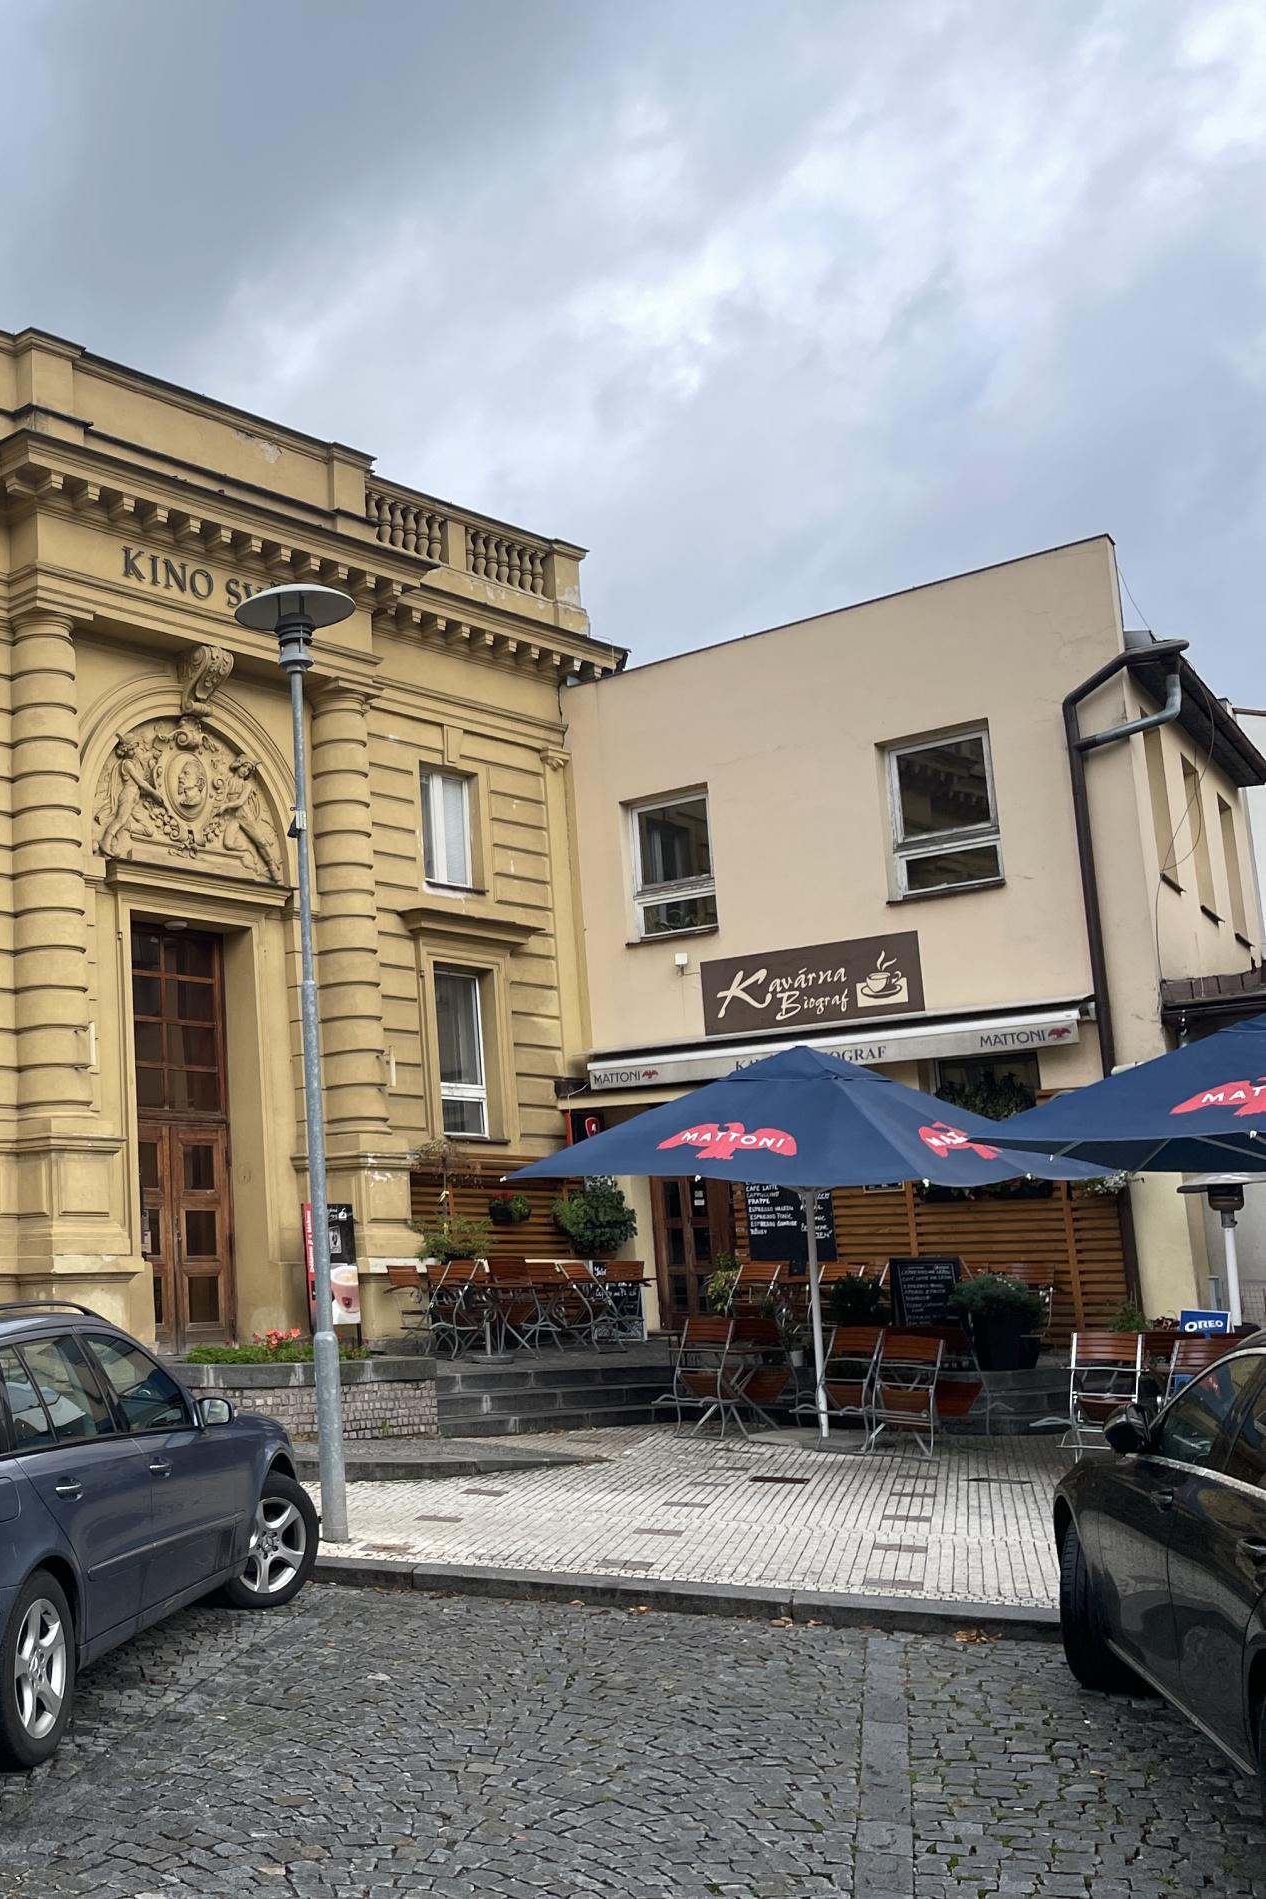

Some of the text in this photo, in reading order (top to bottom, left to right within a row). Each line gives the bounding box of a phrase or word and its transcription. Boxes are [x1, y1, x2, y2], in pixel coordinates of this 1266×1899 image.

[122, 545, 214, 600] KINO
[716, 967, 847, 1018] Kavárna
[776, 988, 849, 1020] Biograf
[980, 1030, 1046, 1048] MATTONI
[594, 1071, 640, 1084] MATTONI
[681, 1131, 785, 1148] MATTONI
[1184, 1320, 1223, 1332] OREO
